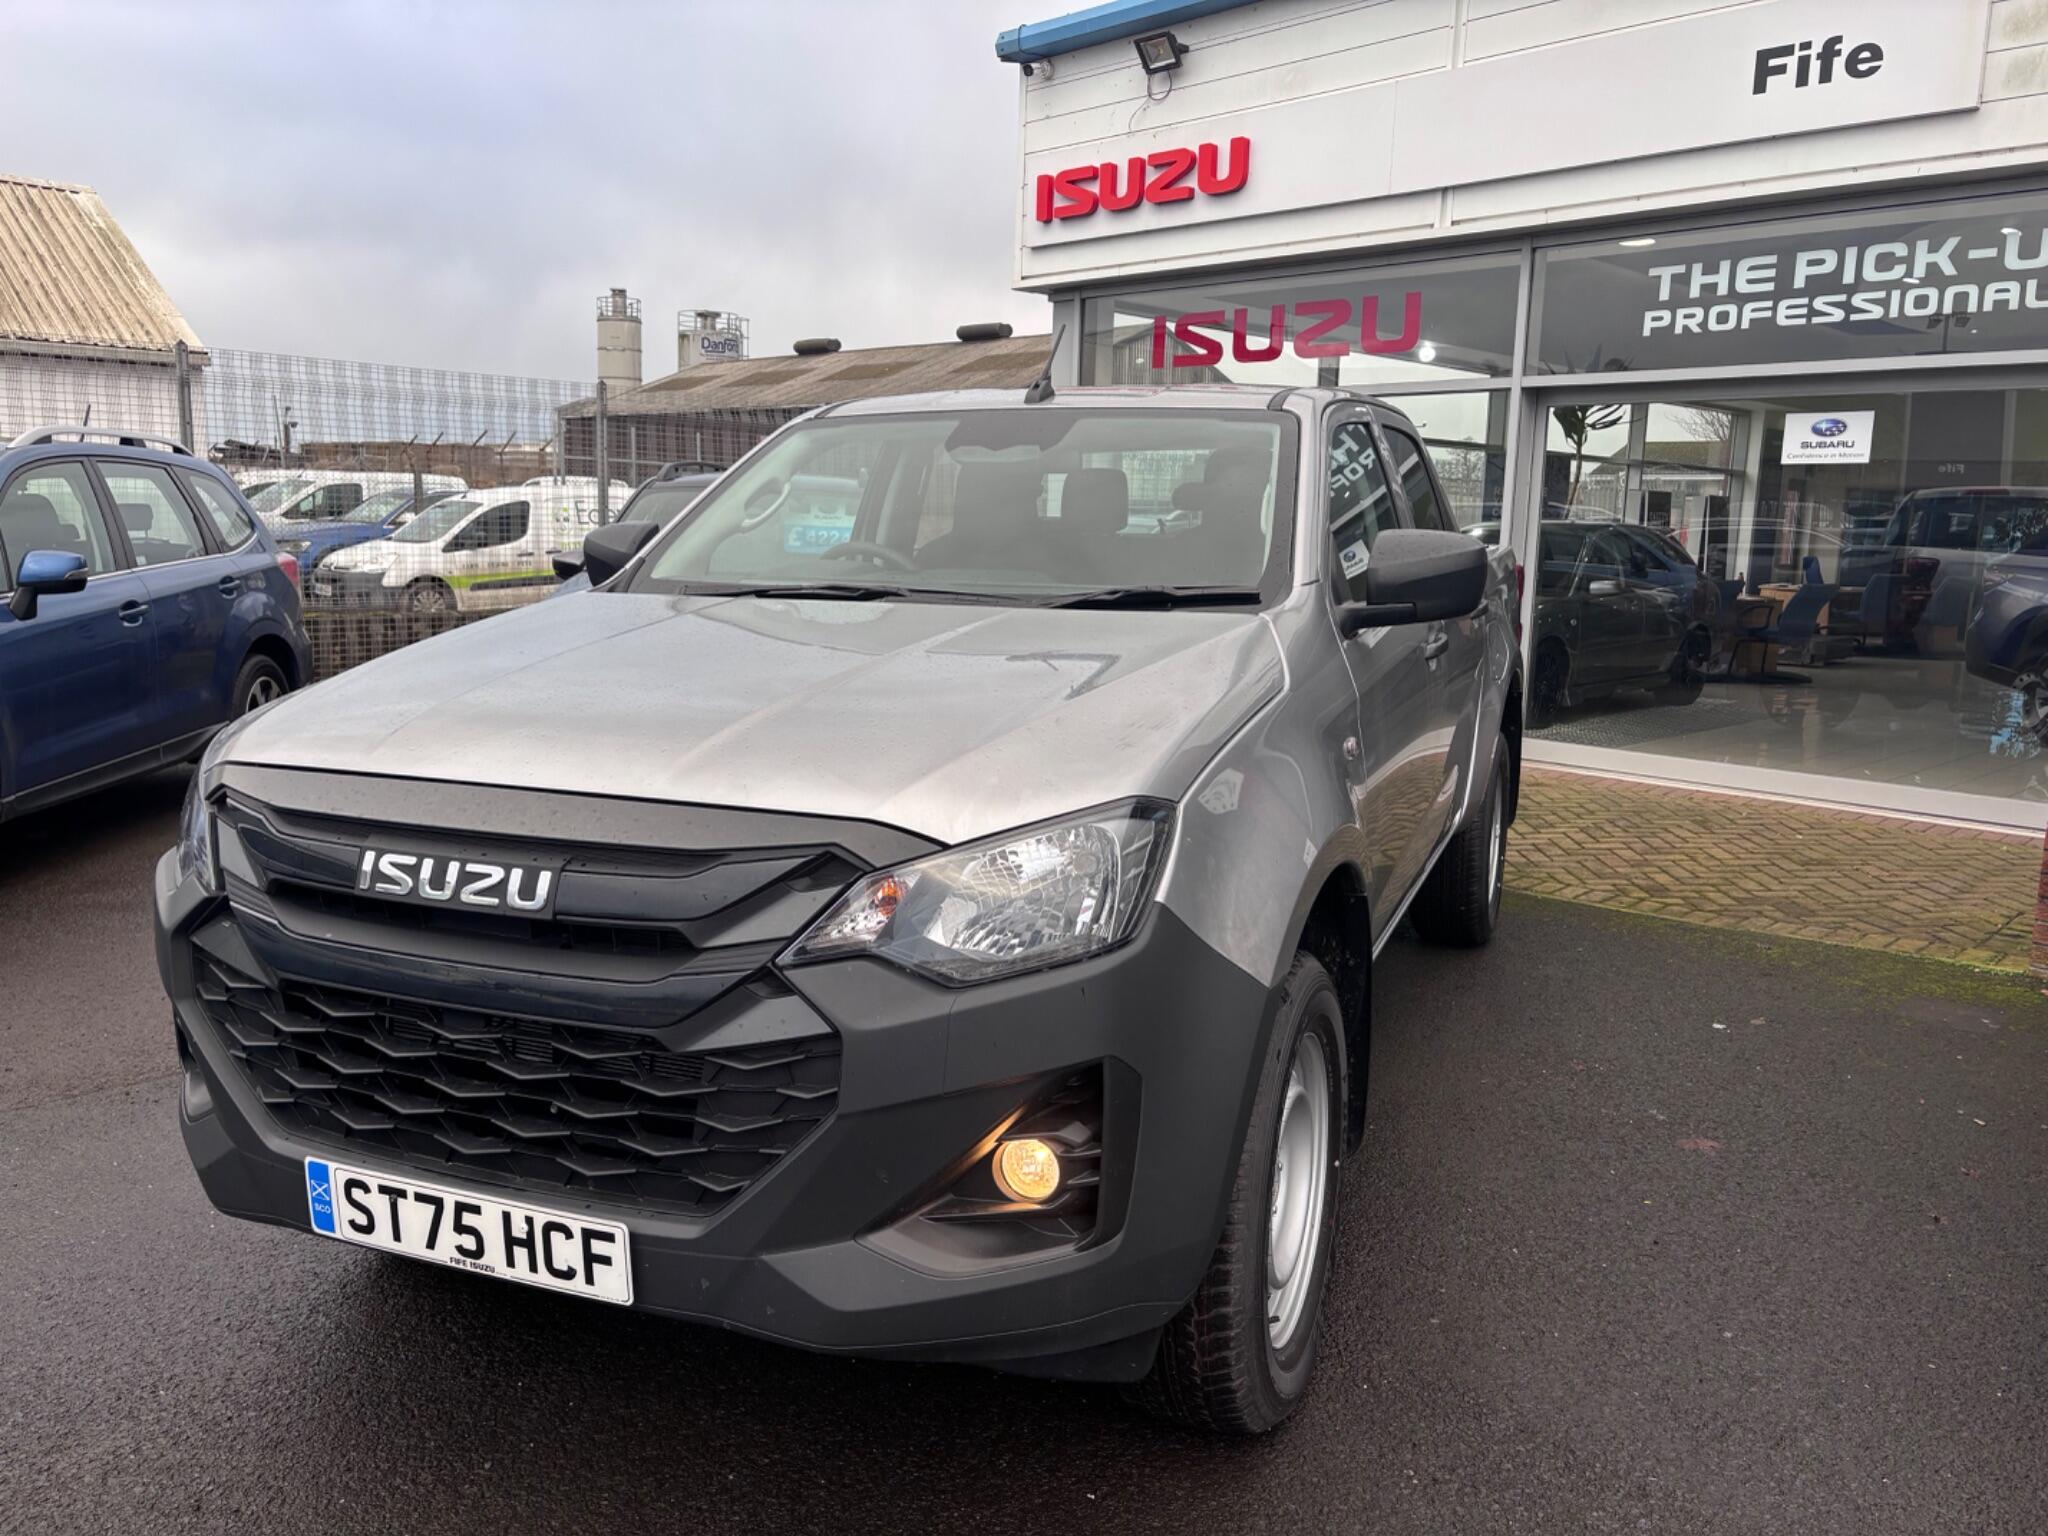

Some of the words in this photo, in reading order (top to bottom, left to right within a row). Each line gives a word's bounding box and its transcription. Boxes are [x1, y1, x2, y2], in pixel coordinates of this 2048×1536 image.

[1752, 34, 1884, 95] Fife
[1036, 136, 1250, 223] ISUZU
[1648, 254, 1778, 301] THE
[1793, 227, 2048, 290] PICK-U
[1152, 292, 1421, 369] ISUZU
[1642, 278, 2048, 337] PROFESSIONAL
[1800, 440, 1855, 449] SUBARU
[359, 850, 552, 910] ISUZU
[343, 1177, 486, 1260] ST75
[502, 1211, 616, 1286] HCF
[450, 1257, 467, 1267] FIFE
[470, 1261, 496, 1273] ISUZU
